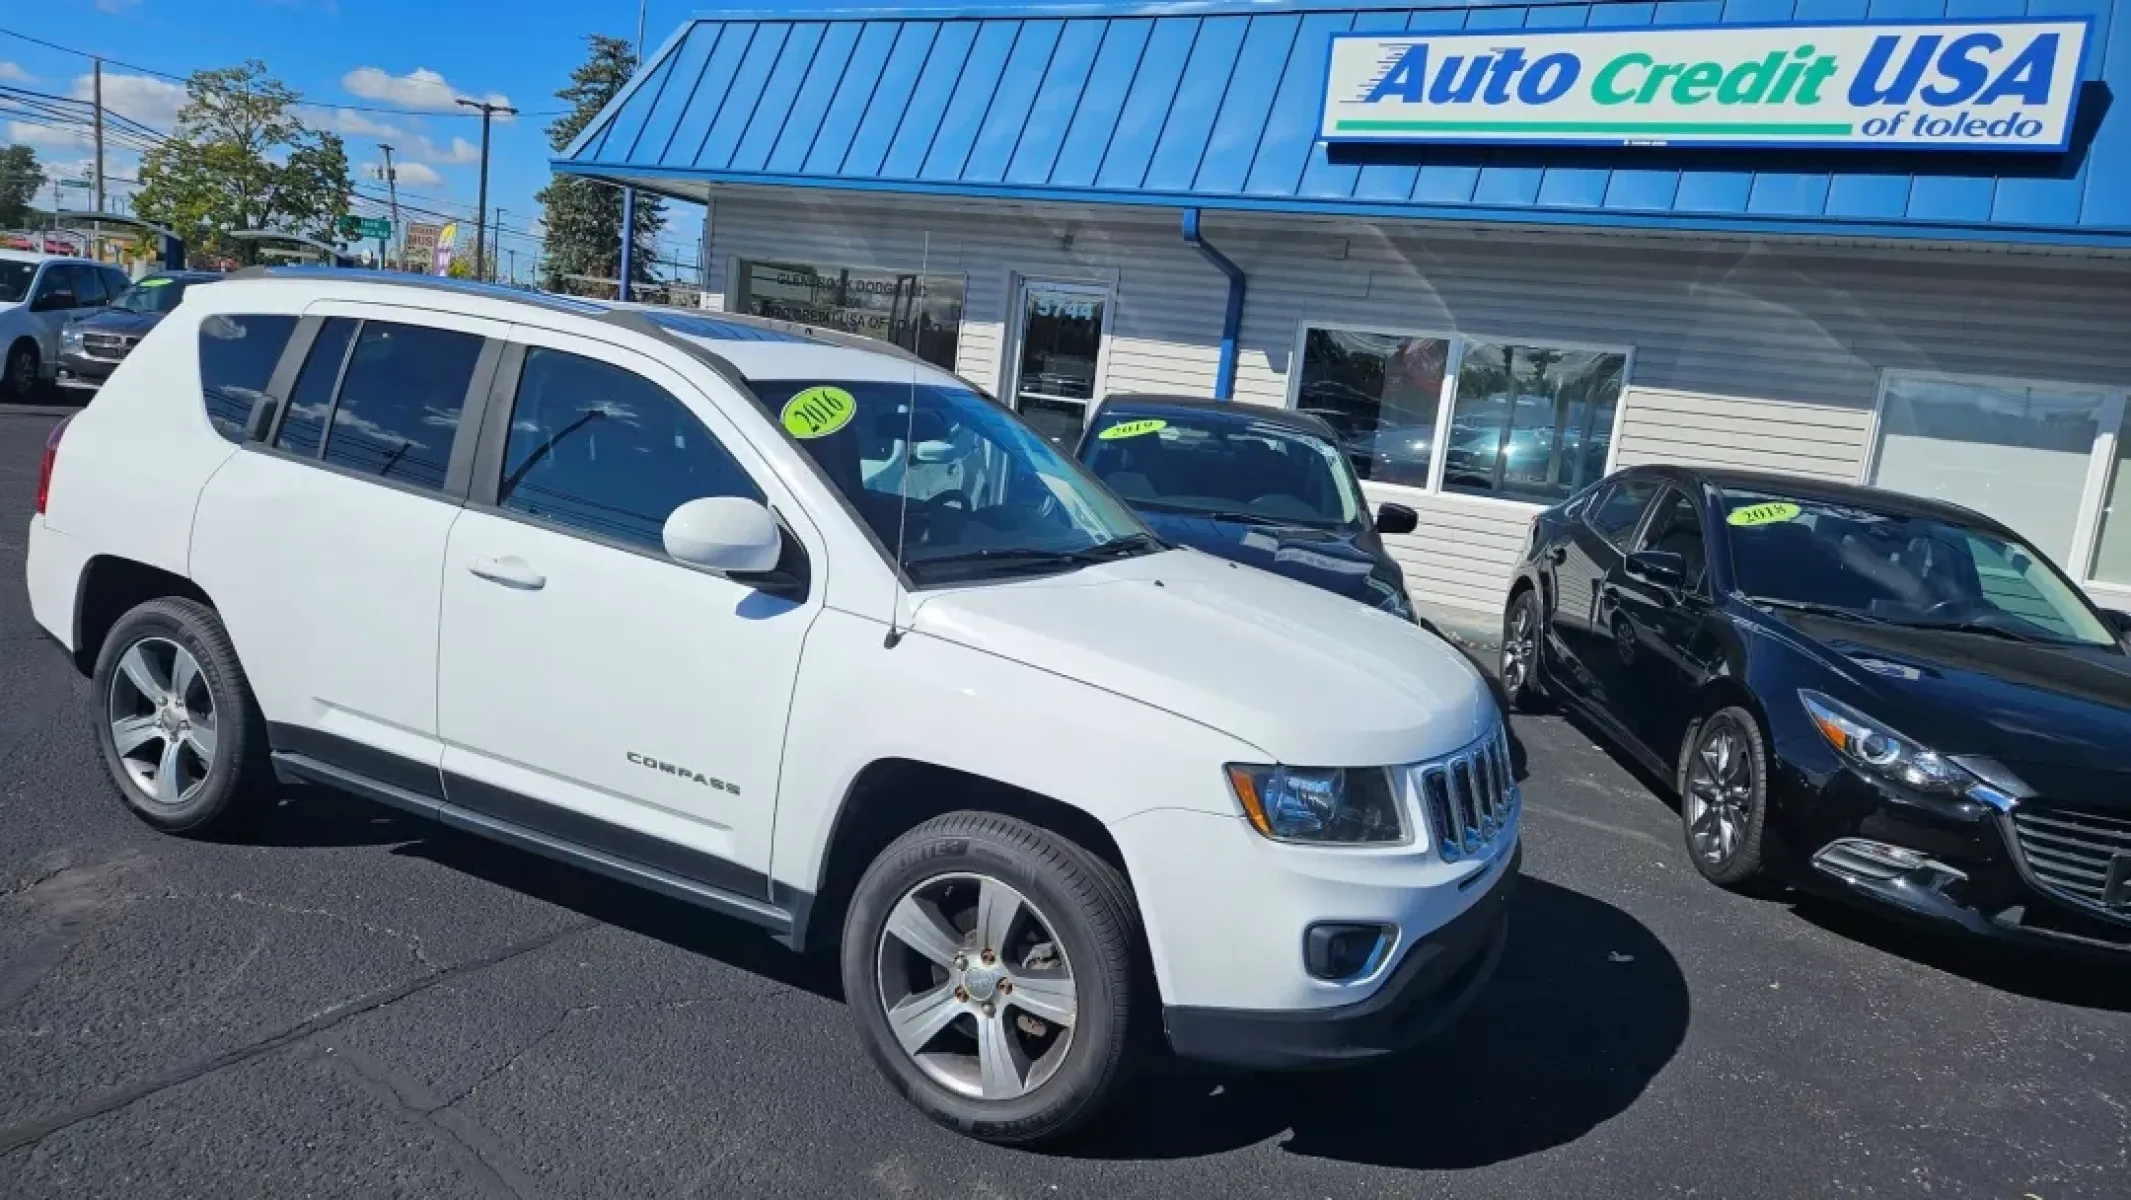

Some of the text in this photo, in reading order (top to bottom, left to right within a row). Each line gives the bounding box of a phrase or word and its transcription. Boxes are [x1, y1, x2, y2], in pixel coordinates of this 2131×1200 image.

[1344, 32, 2060, 108] Auto Credit USA
[1862, 111, 2043, 138] of toledo
[793, 389, 844, 433] 2016
[1743, 505, 1786, 523] 2018
[626, 751, 741, 796] COMPASS
